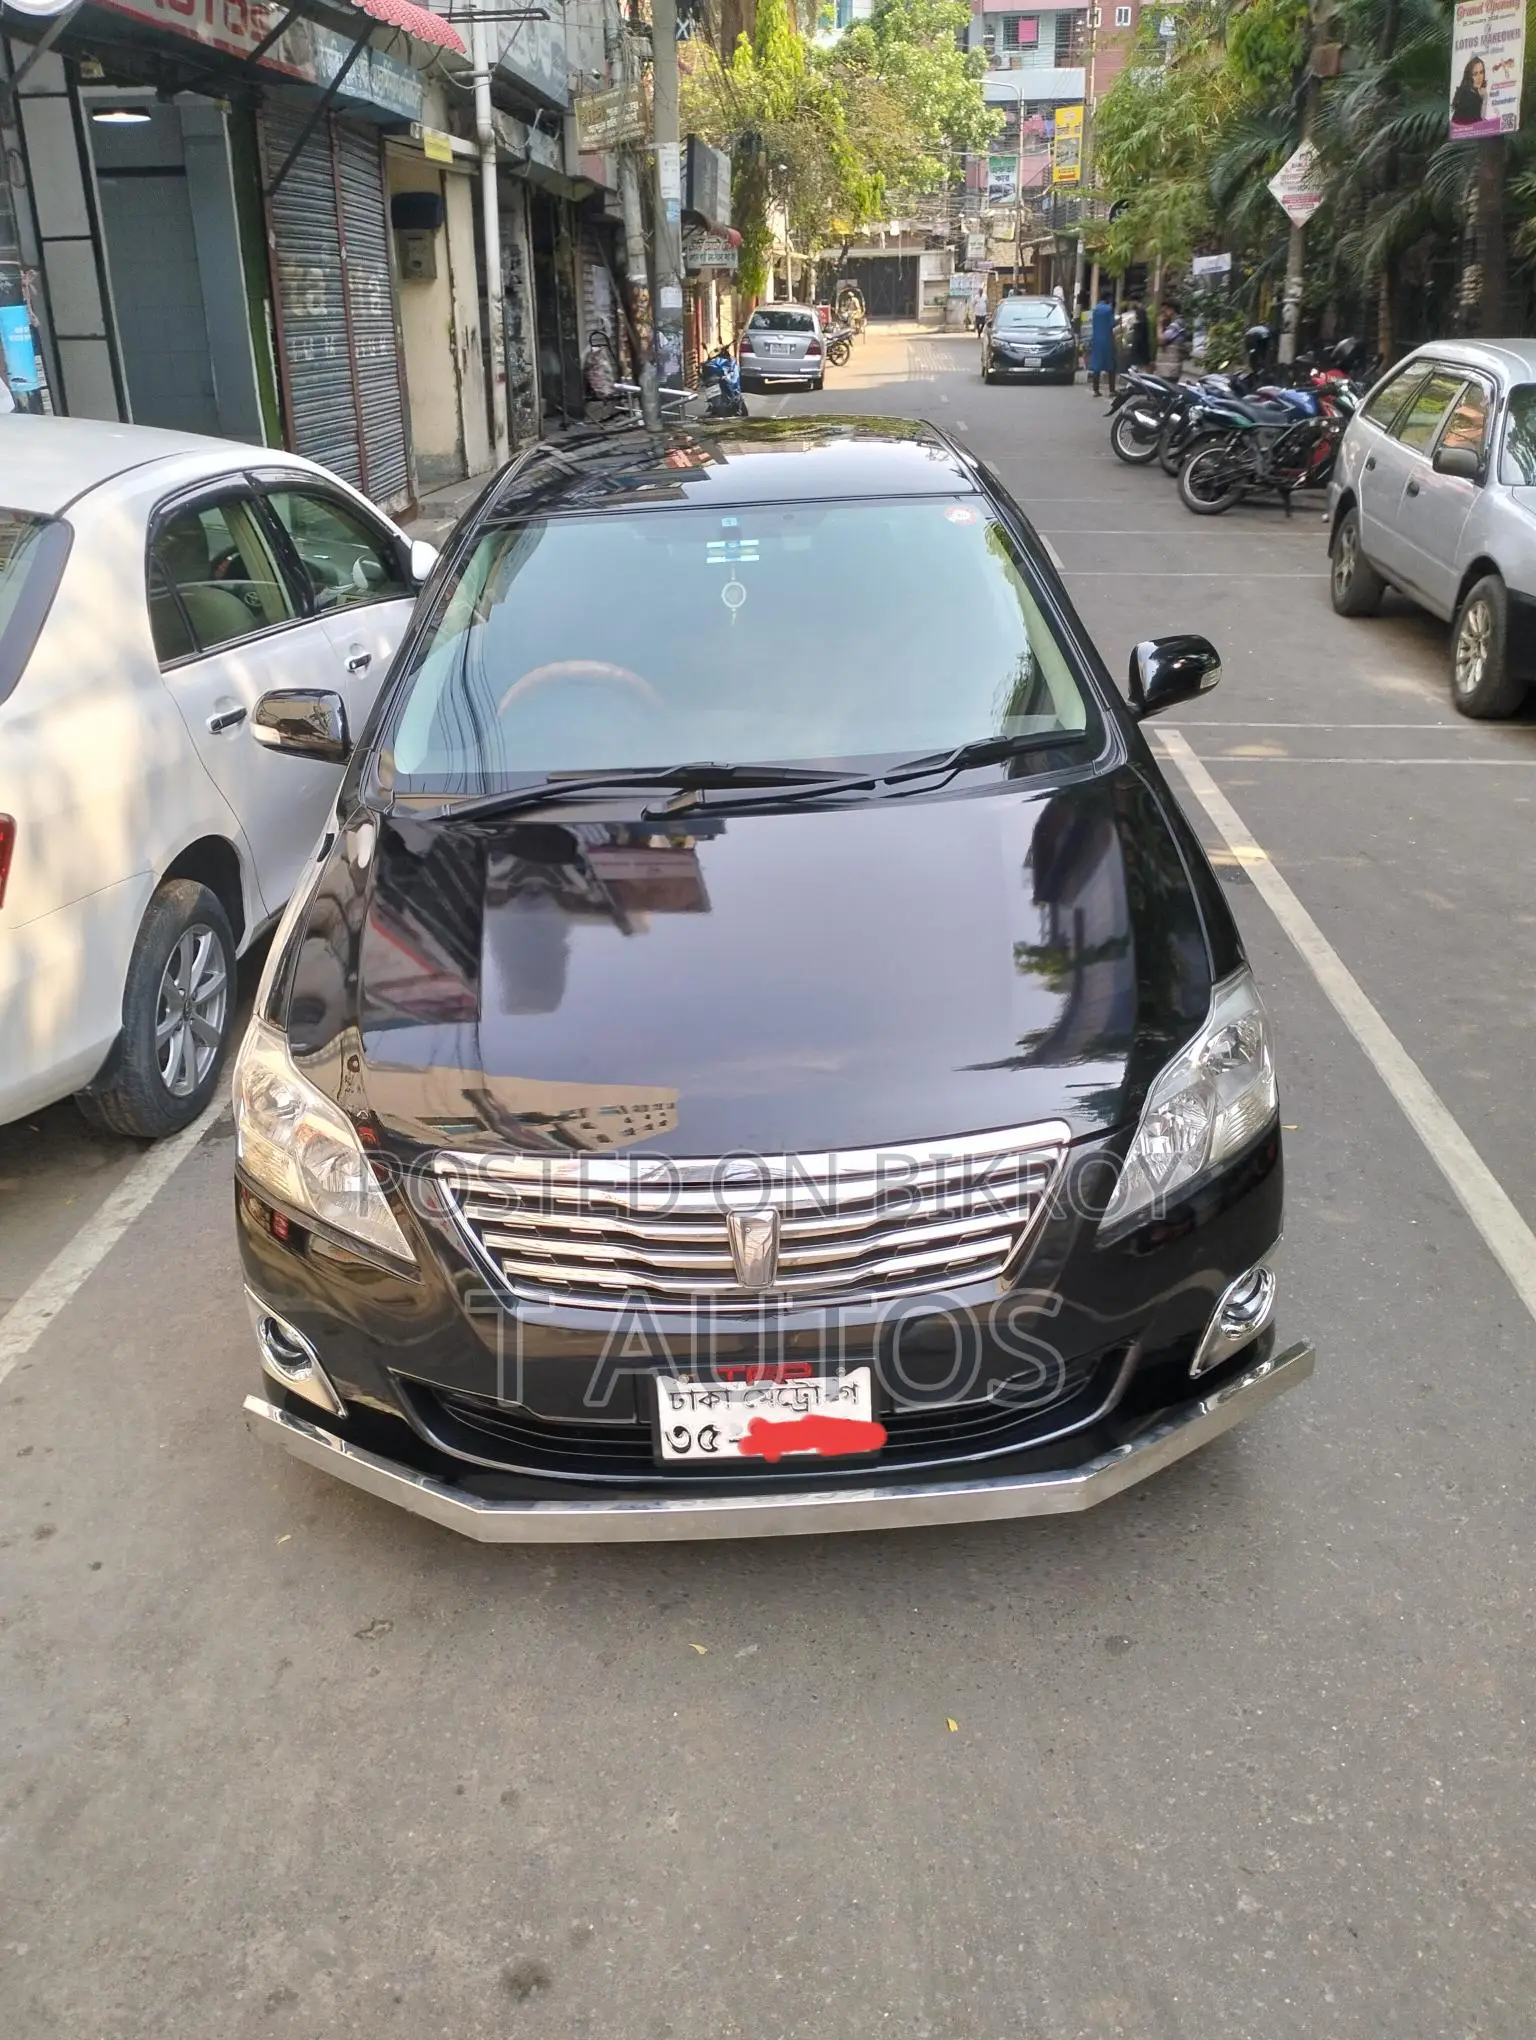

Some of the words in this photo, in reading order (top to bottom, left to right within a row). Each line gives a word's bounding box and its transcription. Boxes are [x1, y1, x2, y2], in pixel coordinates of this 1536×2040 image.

[1455, 36, 1479, 51] LOTUS
[1480, 28, 1521, 45] MAKEOVER
[668, 1389, 730, 1411] ঢাকা
